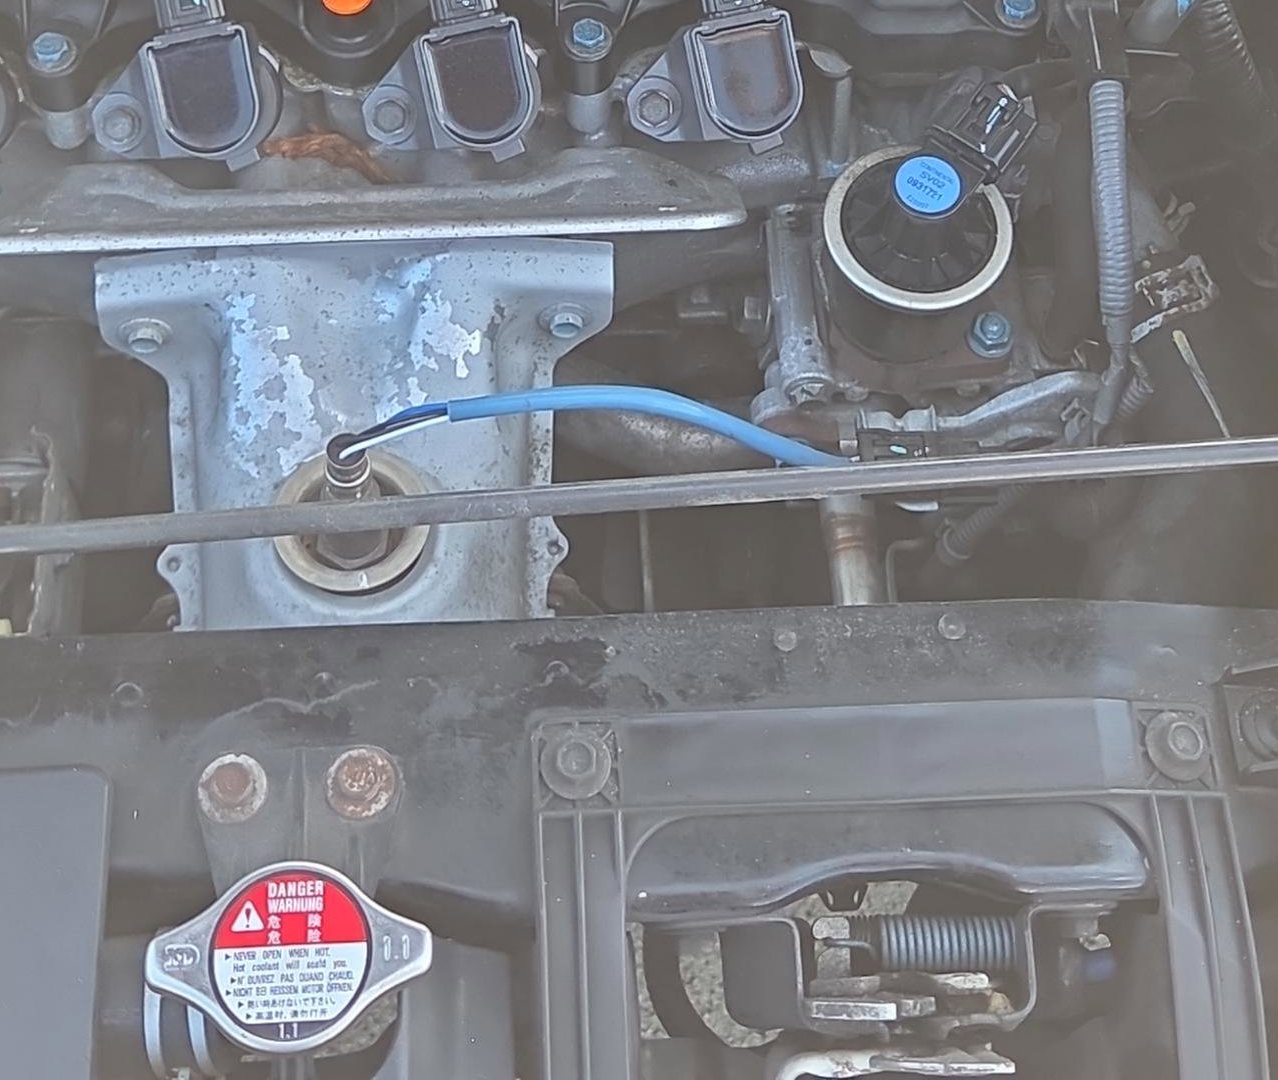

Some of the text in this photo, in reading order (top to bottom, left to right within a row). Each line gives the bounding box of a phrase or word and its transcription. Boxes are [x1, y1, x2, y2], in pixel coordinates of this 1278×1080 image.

[268, 880, 324, 898] DANGER
[268, 896, 324, 913] WARNUNG
[233, 952, 256, 961] NEVER
[262, 950, 282, 960] OPEN
[289, 948, 309, 958] WHEN
[233, 964, 246, 972] Hot
[252, 962, 279, 972] coolant
[286, 960, 299, 969] will
[307, 959, 326, 969] scald
[280, 973, 294, 982] PAS
[233, 988, 253, 997] NICHT
[256, 987, 267, 996] BEI
[278, 1023, 299, 1039] 1.1
